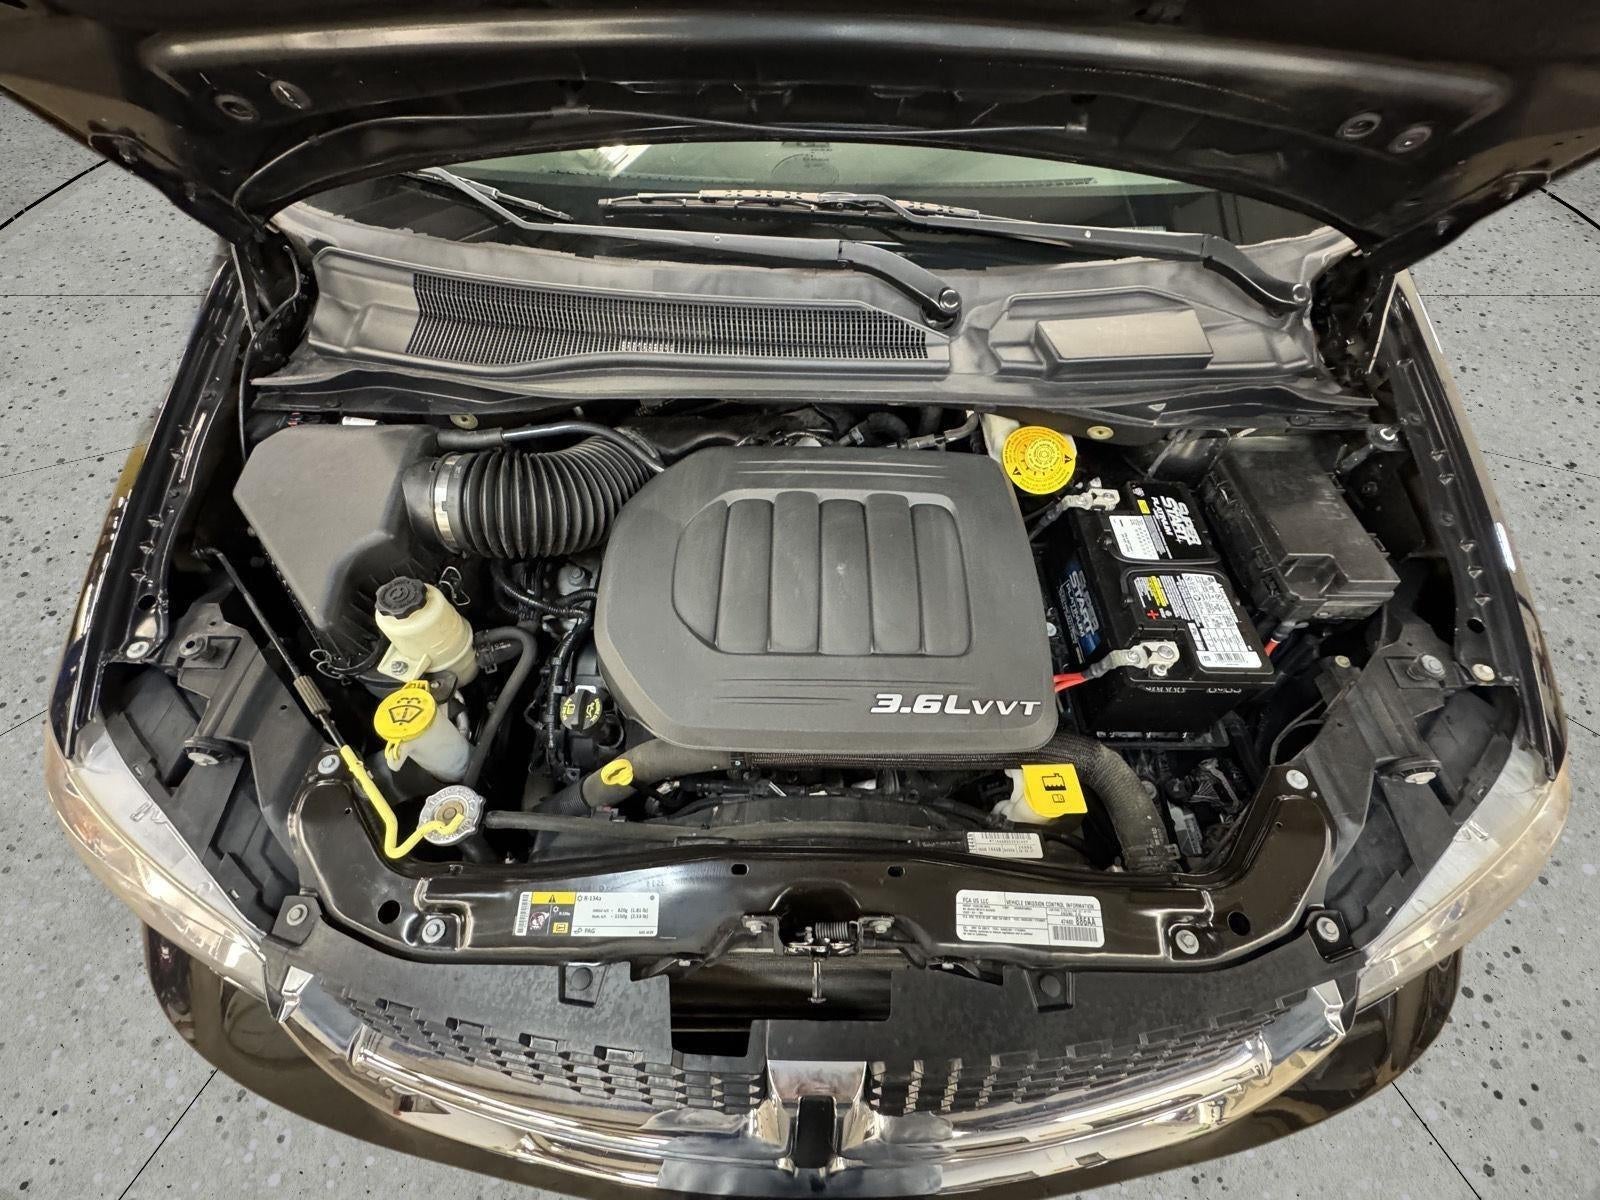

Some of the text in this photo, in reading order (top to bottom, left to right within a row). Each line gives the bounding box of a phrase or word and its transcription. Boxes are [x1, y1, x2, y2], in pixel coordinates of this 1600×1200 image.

[1150, 496, 1174, 536] PLATINUM
[1159, 495, 1188, 545] START
[1176, 502, 1202, 546] SUPER
[1065, 582, 1086, 638] PLATINUM
[1069, 570, 1095, 636] START
